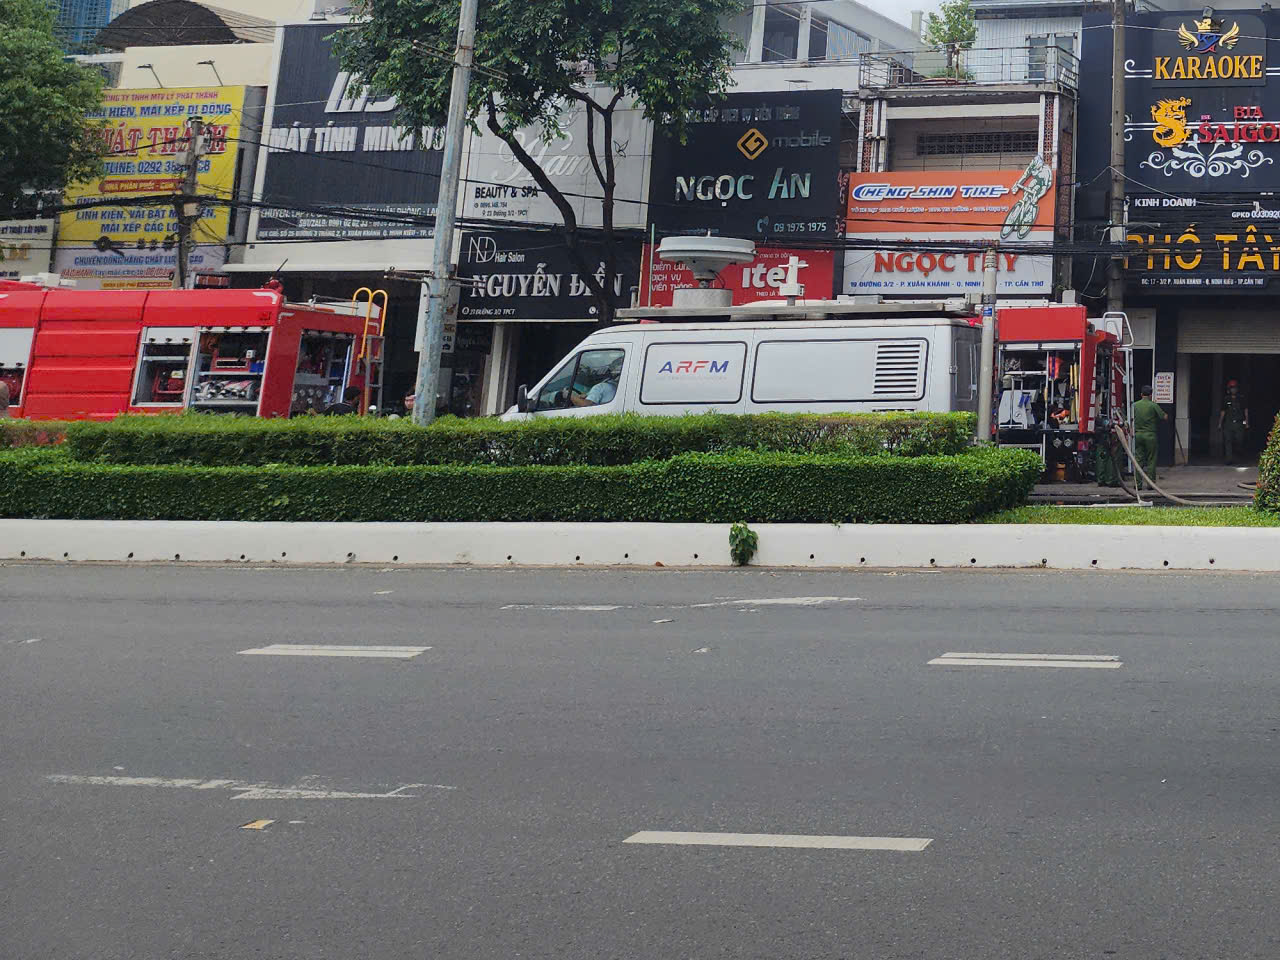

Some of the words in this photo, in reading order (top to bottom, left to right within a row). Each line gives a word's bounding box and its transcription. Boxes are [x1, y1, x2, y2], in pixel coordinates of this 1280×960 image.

[1155, 55, 1263, 80] KARAOKE
[1234, 106, 1264, 118] BIA
[314, 120, 358, 152] TÍNH
[772, 130, 831, 147] mobile
[474, 187, 509, 198] BEAUTY
[510, 187, 517, 198] &
[521, 187, 538, 198] SPA
[674, 174, 754, 207] NGỌC
[853, 184, 909, 200] CHENG
[910, 186, 956, 198] SHIN
[961, 186, 1007, 198] TIRE
[1134, 198, 1161, 207] KINH
[1162, 198, 1196, 207] DOANH
[774, 222, 785, 232] 09
[786, 222, 806, 232] 1975
[807, 222, 827, 232] 1975
[1124, 222, 1202, 270] PHỐ
[494, 252, 507, 263] Hair
[508, 252, 526, 263] Salon
[874, 252, 956, 277] NGỌC
[470, 262, 562, 298] NGUYỄN
[906, 280, 926, 288] XUÂN
[658, 360, 729, 374] ARFM
